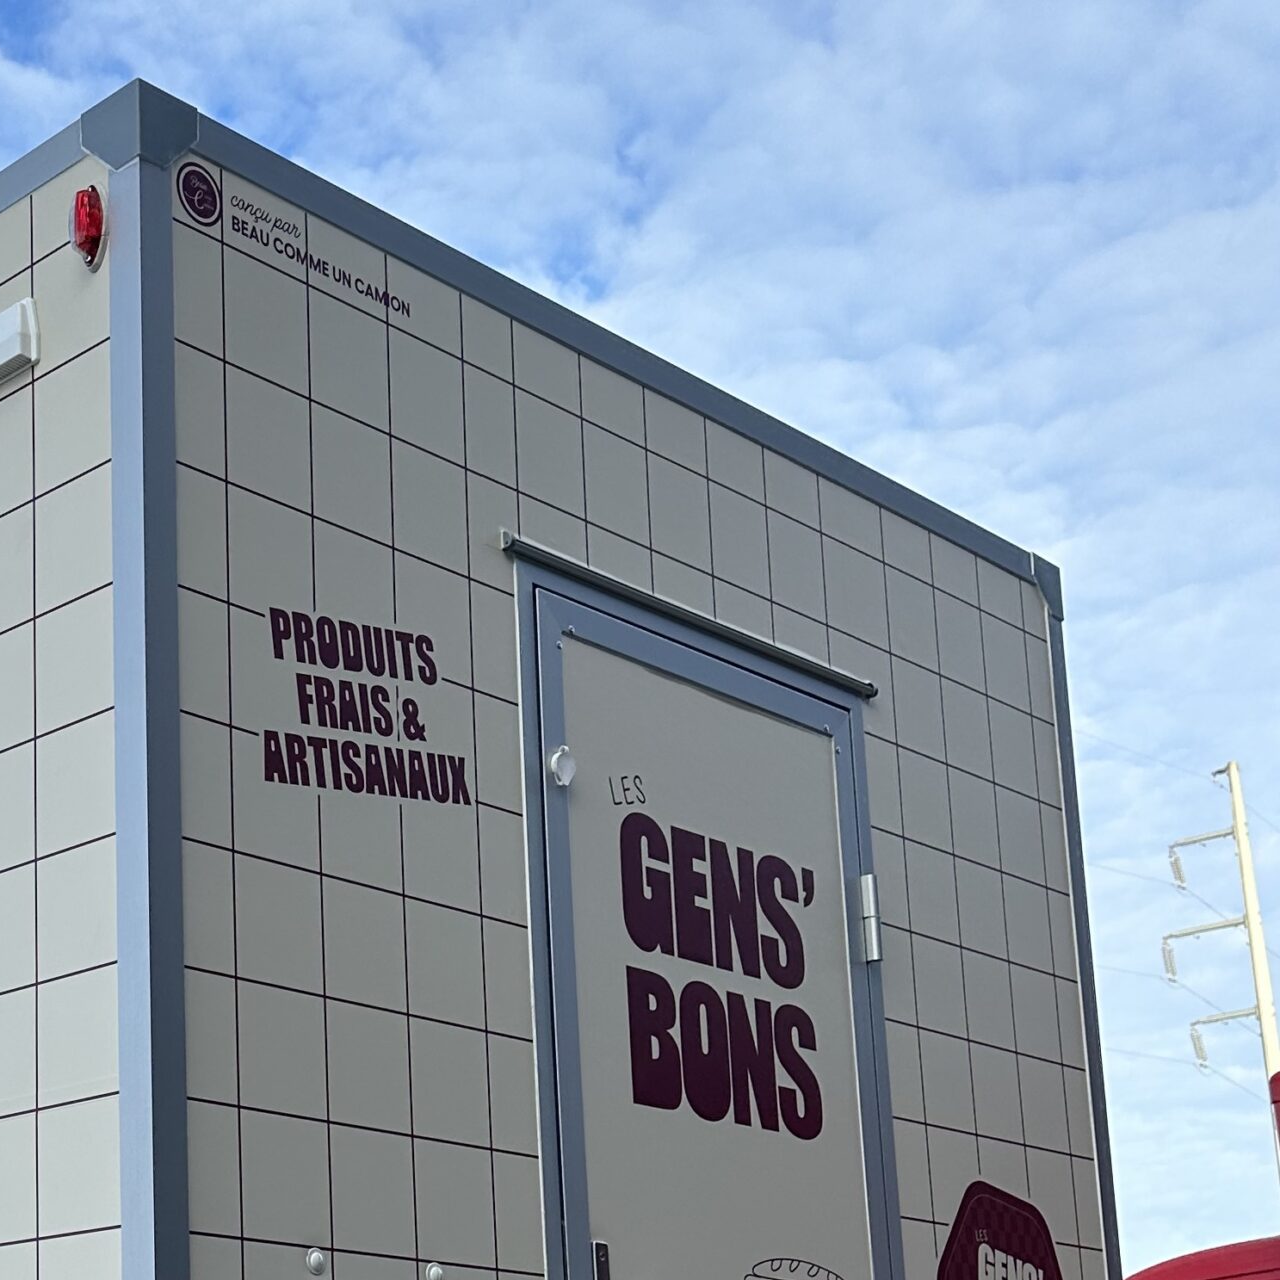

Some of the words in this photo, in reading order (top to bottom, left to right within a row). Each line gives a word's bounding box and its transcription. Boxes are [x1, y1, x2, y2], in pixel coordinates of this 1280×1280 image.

[231, 194, 271, 224] conçu
[272, 216, 300, 238] par
[232, 216, 270, 247] BEAU
[274, 237, 329, 277] COMME
[333, 265, 352, 288] UN
[354, 279, 410, 318] CAMION
[269, 607, 438, 685] PRODUITS
[296, 672, 394, 736] FRAIS
[402, 698, 426, 742] &
[264, 730, 472, 806] ARTISANAUX
[608, 775, 646, 806] LES
[620, 812, 814, 990] GENS'
[626, 964, 823, 1140] BONS
